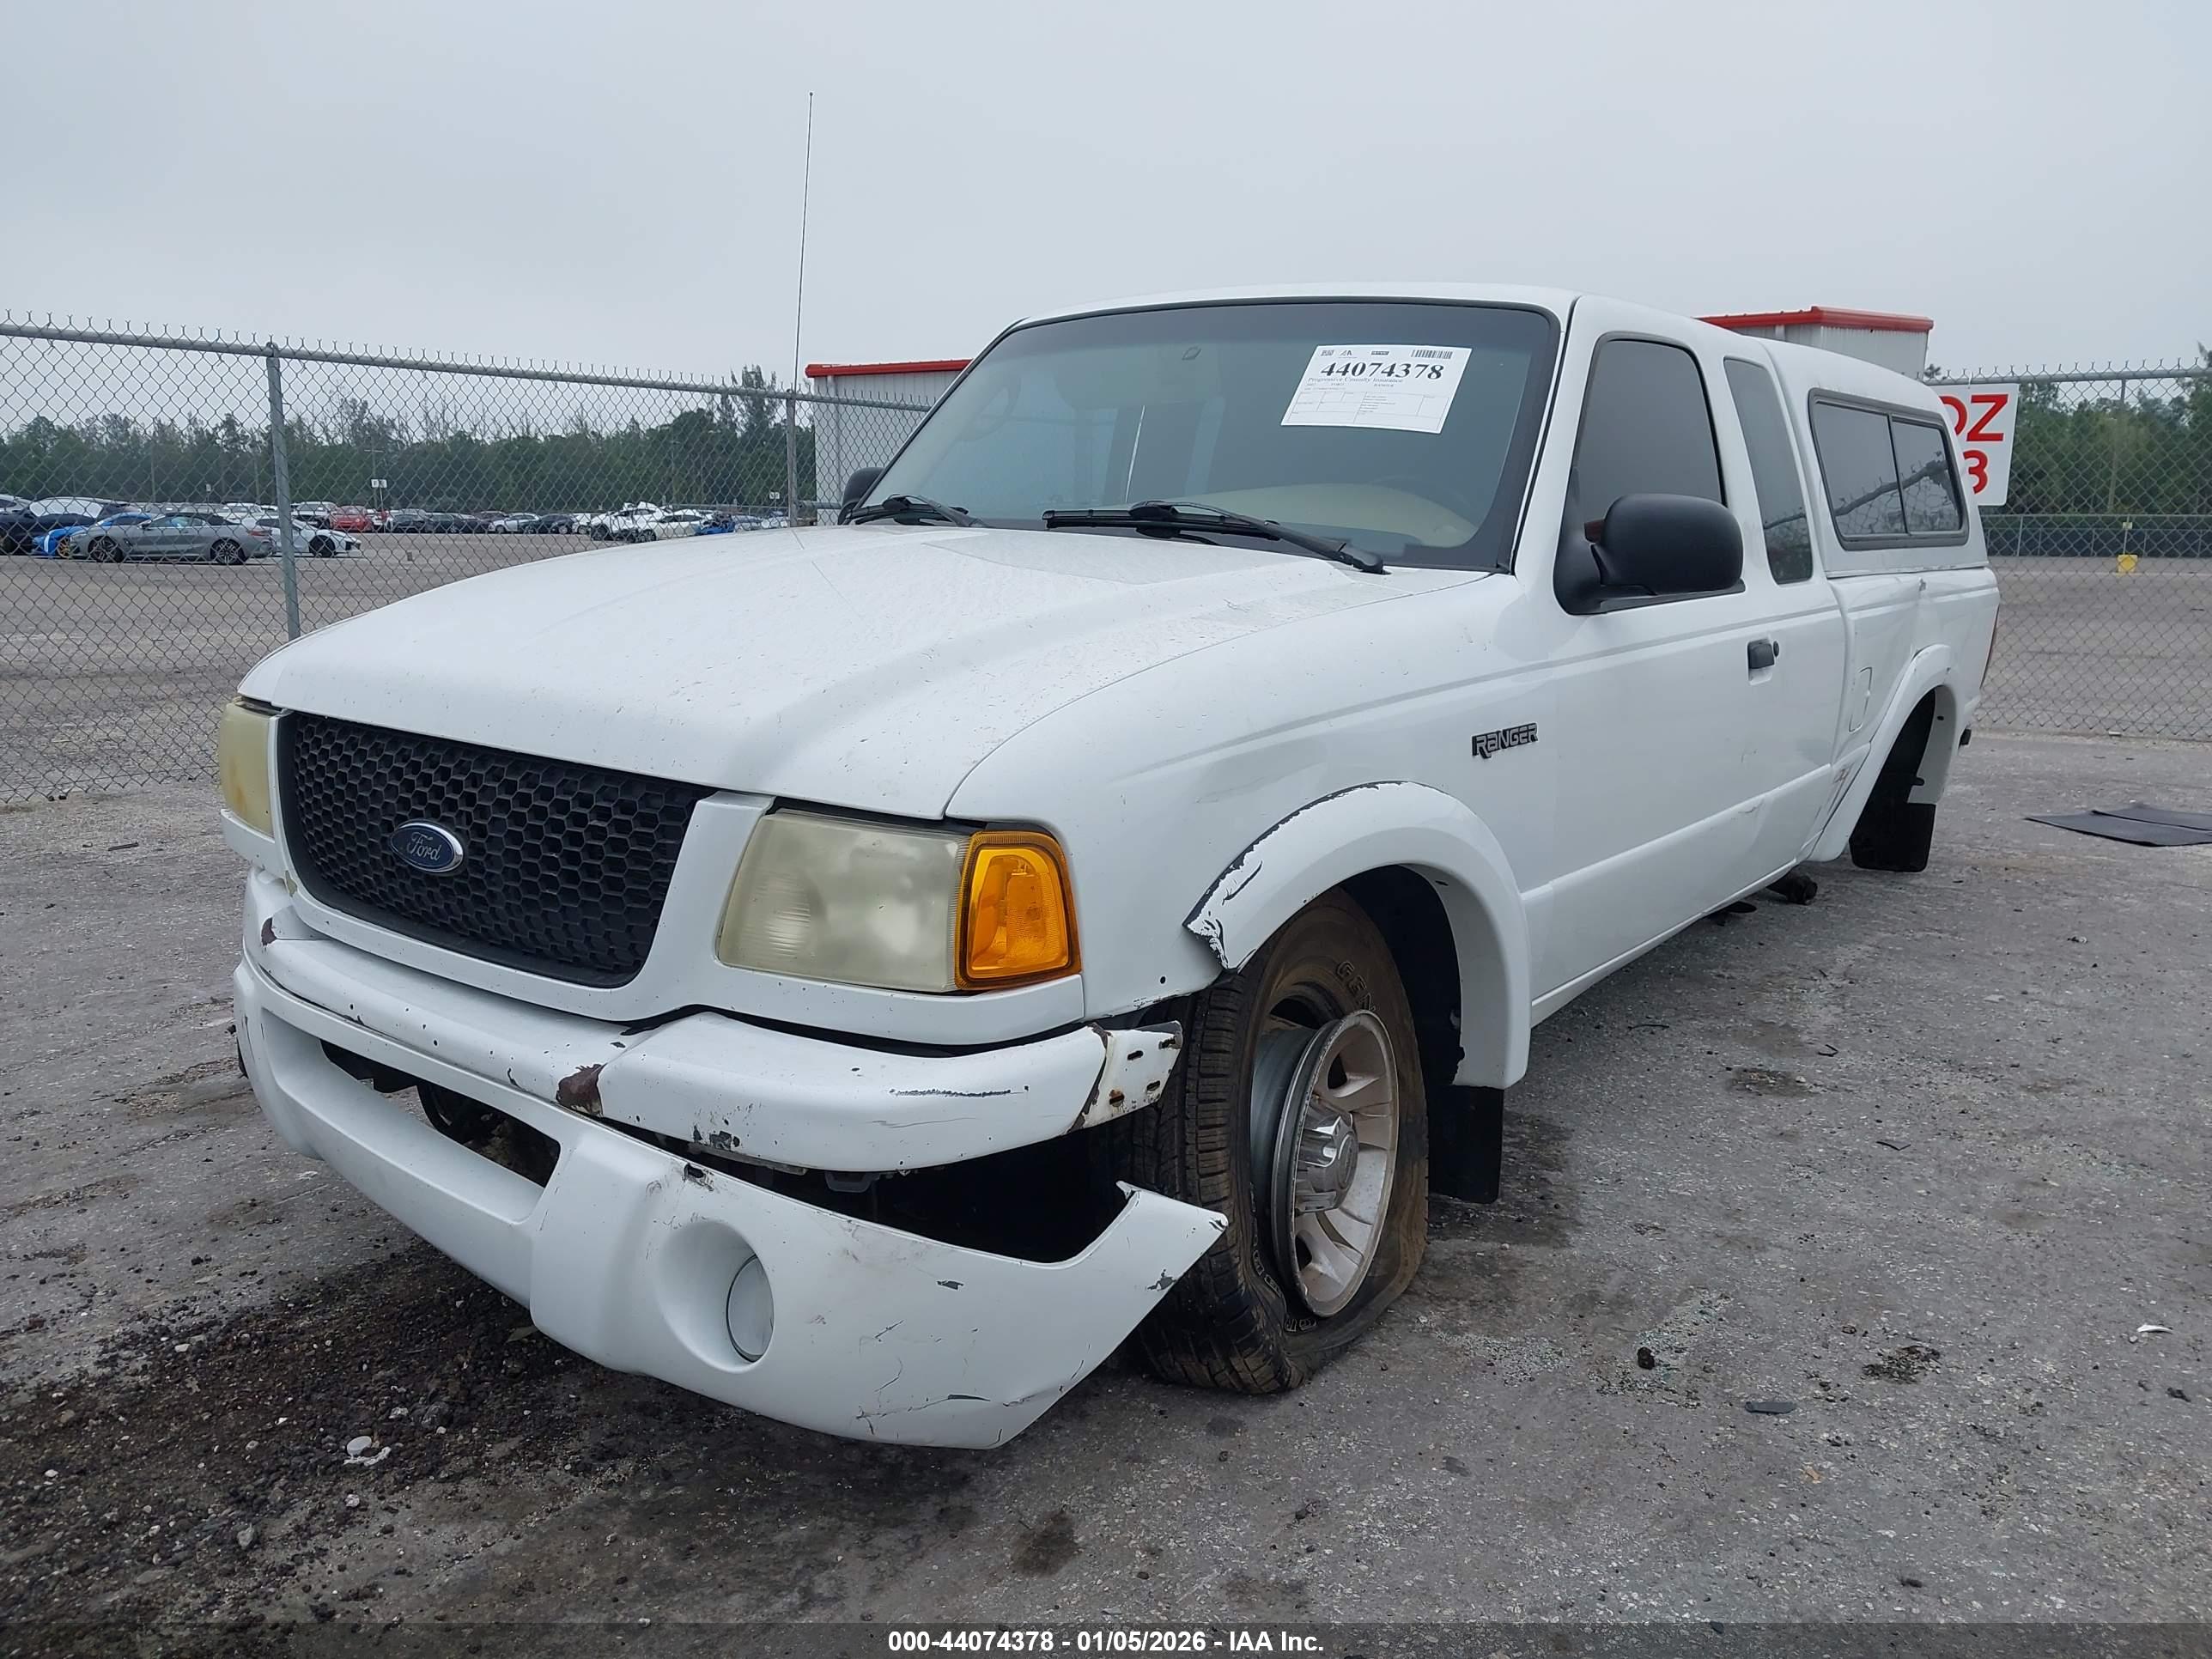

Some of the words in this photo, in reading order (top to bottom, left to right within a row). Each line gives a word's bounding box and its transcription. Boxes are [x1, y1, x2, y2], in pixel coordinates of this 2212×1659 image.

[1321, 362, 1444, 380] 44074378
[1472, 722, 1539, 759] RANGER
[407, 831, 441, 861] Ford
